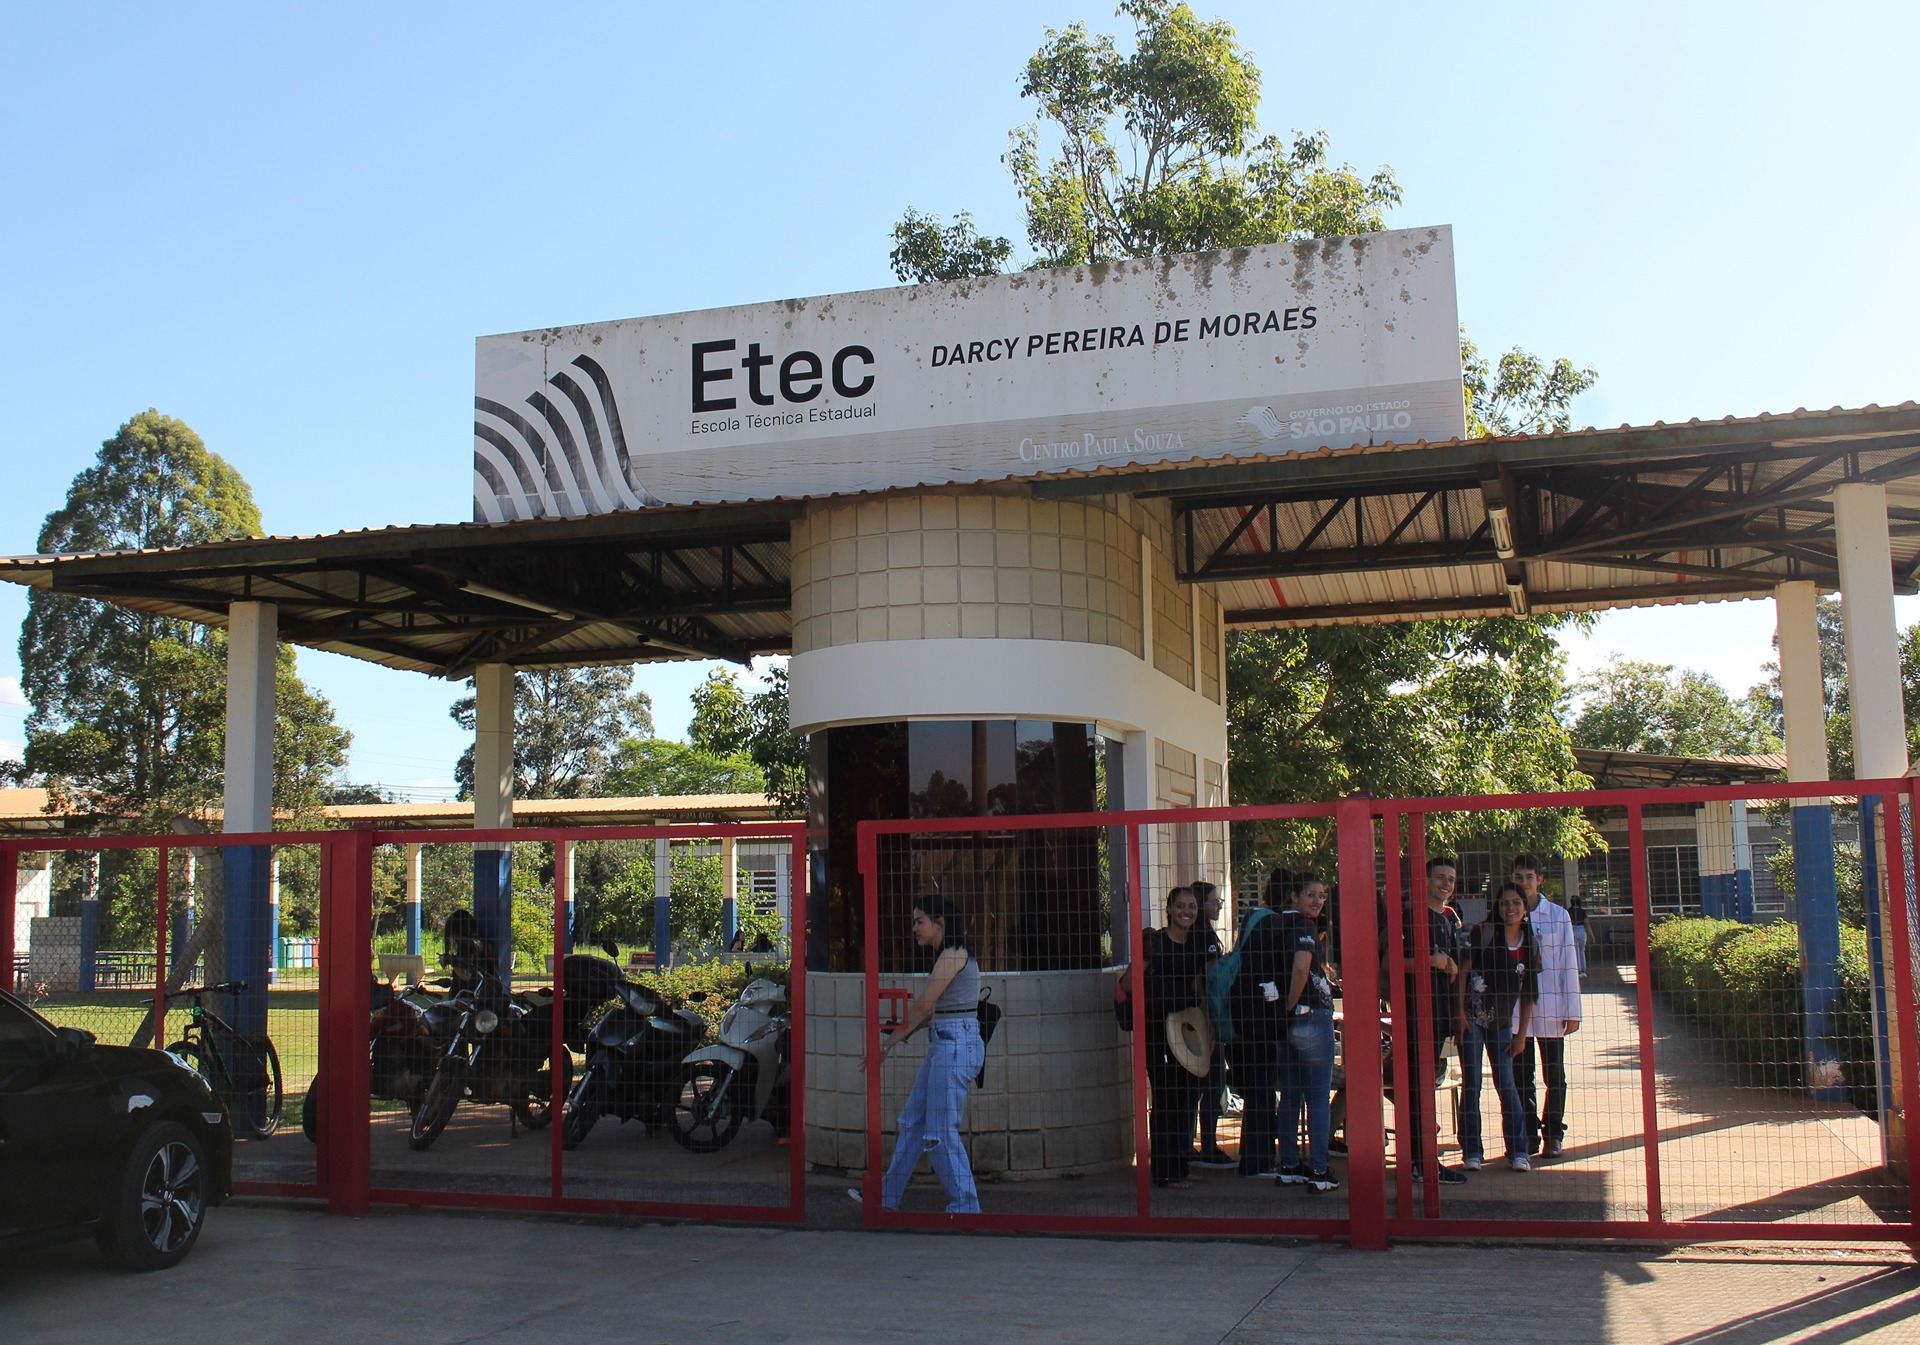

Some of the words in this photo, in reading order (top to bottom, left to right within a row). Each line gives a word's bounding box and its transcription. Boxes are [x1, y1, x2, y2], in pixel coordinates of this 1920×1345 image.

[931, 336, 1020, 368] DARCY
[1027, 324, 1145, 357] PEREIRA
[1154, 318, 1191, 344] DE
[1198, 306, 1317, 340] MORAES
[691, 338, 875, 414] Etec
[691, 417, 740, 434] Escola
[746, 411, 804, 429] Técnica
[809, 402, 877, 423] Estadual
[1289, 406, 1343, 420] GOVERNO
[1346, 404, 1364, 414] DO
[1366, 399, 1411, 411] ESTADO
[1289, 417, 1336, 439] SÃO
[1339, 411, 1412, 434] PAULO
[1019, 437, 1081, 462] CENTRO
[1083, 432, 1131, 457] PAULA
[1134, 428, 1185, 452] SOUZA
